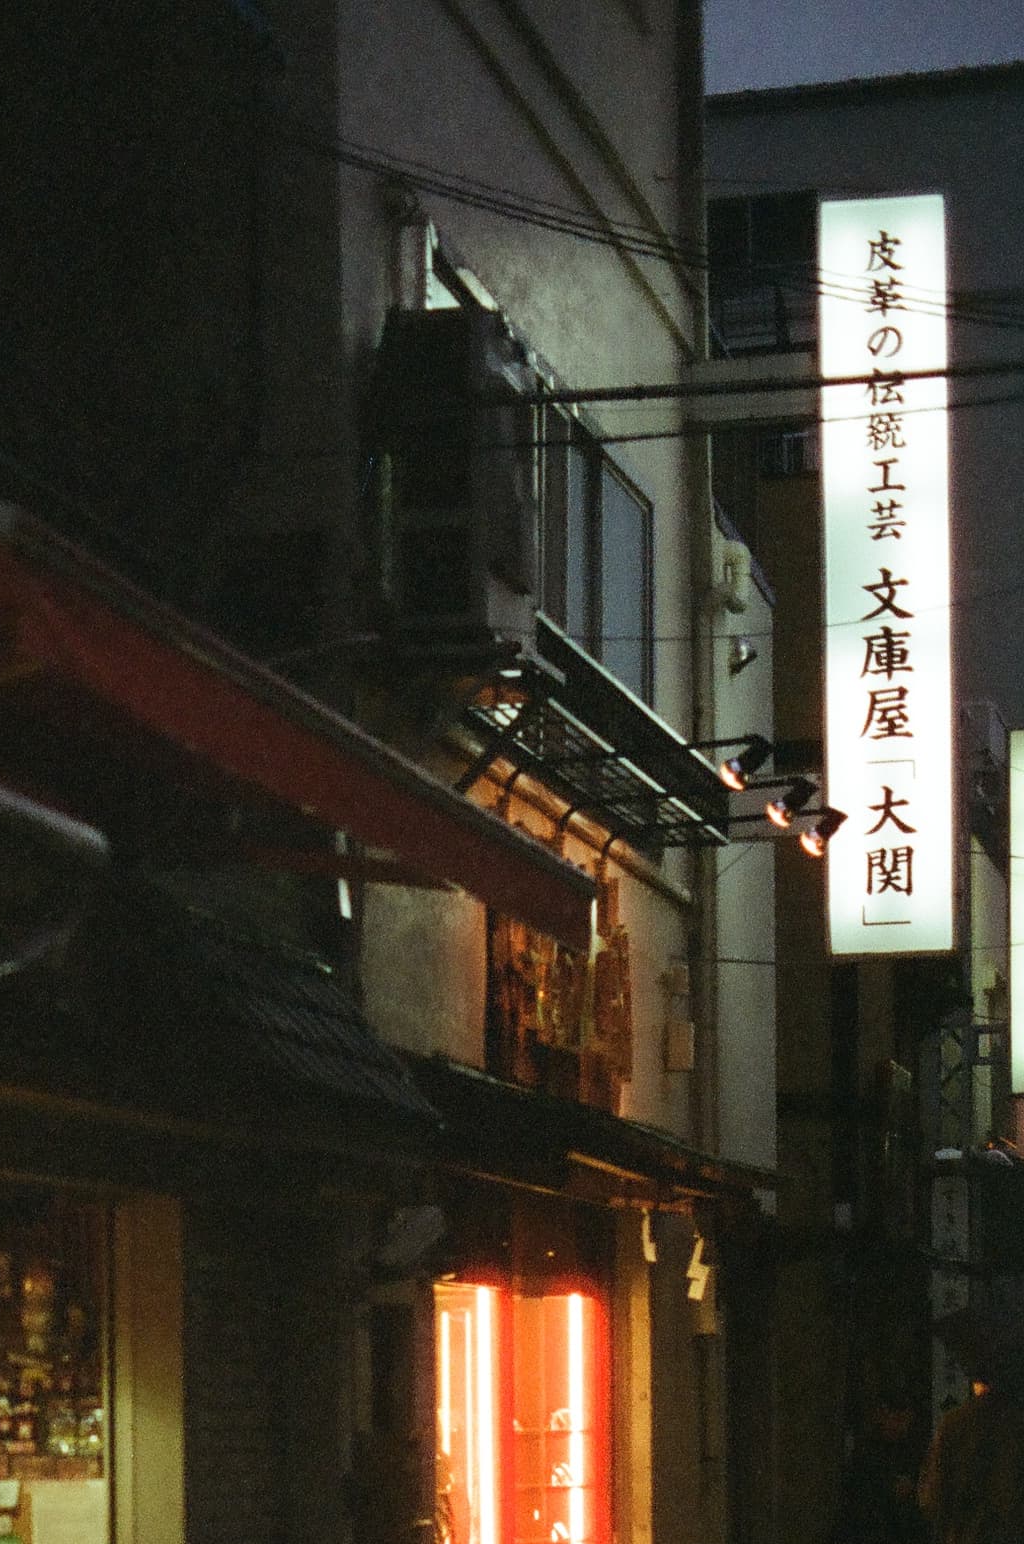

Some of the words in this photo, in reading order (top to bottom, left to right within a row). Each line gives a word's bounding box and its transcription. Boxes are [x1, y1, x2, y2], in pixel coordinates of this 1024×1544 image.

[866, 230, 907, 541] 皮革の伝統工芸
[860, 567, 917, 926] 文庫屋「大関」
